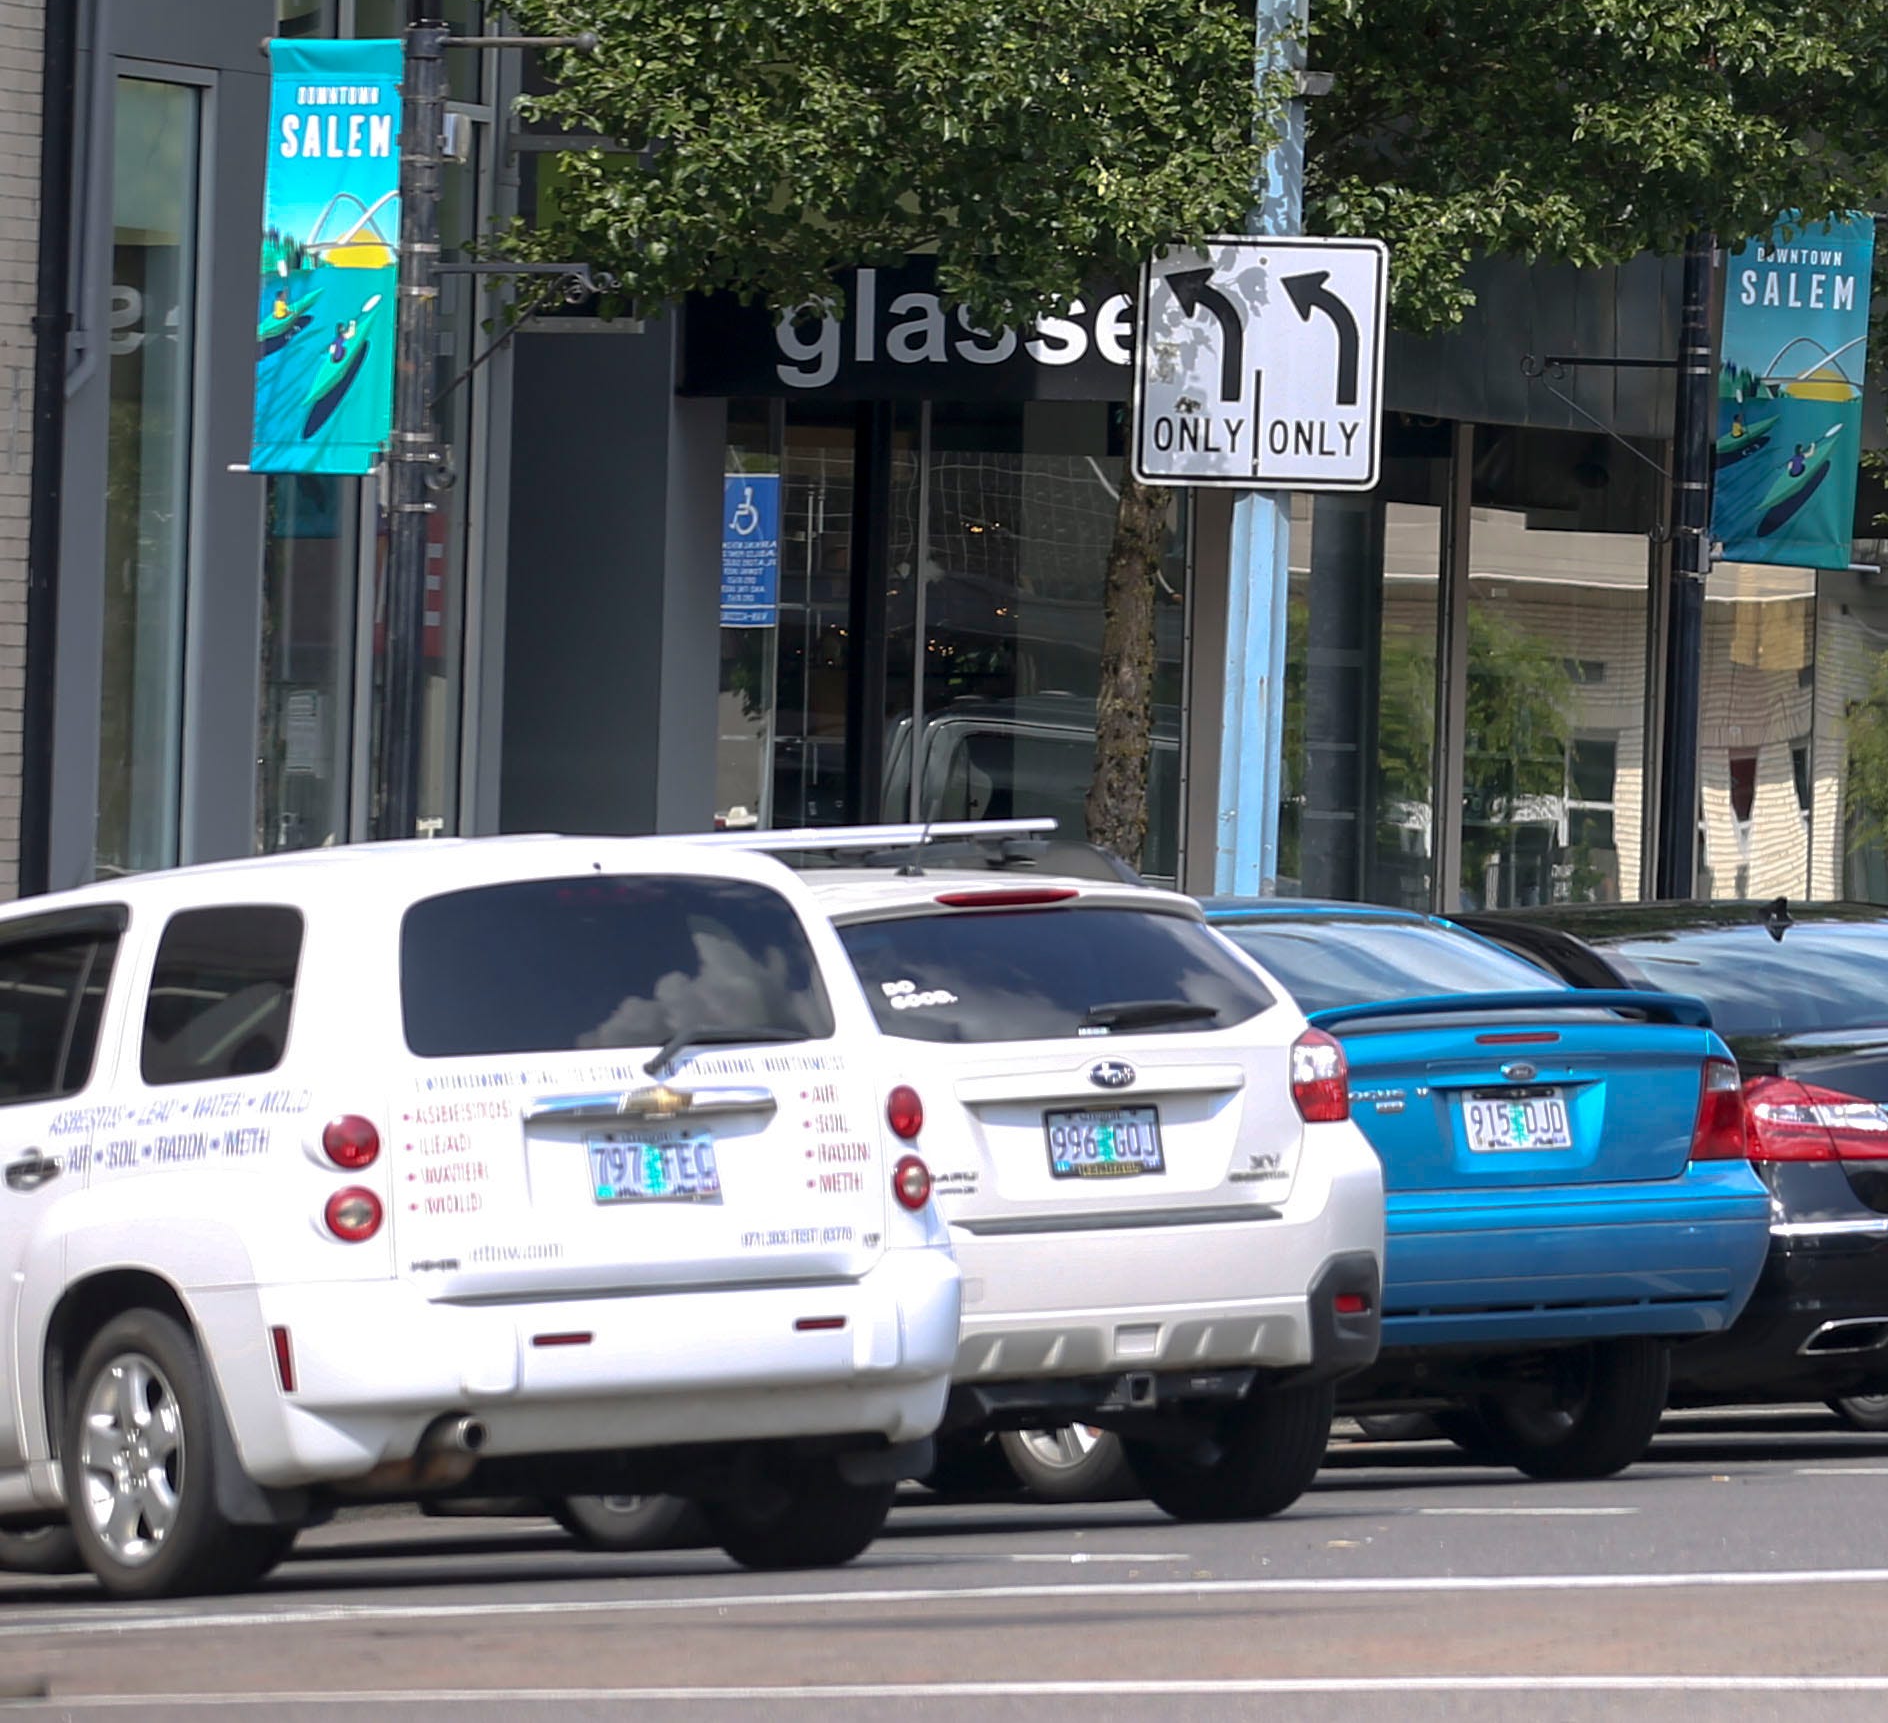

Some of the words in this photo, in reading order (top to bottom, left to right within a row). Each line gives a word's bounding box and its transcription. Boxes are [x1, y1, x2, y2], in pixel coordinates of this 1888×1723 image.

[280, 114, 392, 158] SALEM
[1740, 269, 1855, 311] SALEM
[775, 268, 1132, 388] glasse
[1153, 416, 1245, 453] ONLY
[1268, 419, 1360, 457] ONLY
[1470, 1103, 1511, 1137] 915
[1524, 1101, 1565, 1134] DJD
[1051, 1125, 1098, 1160] 996
